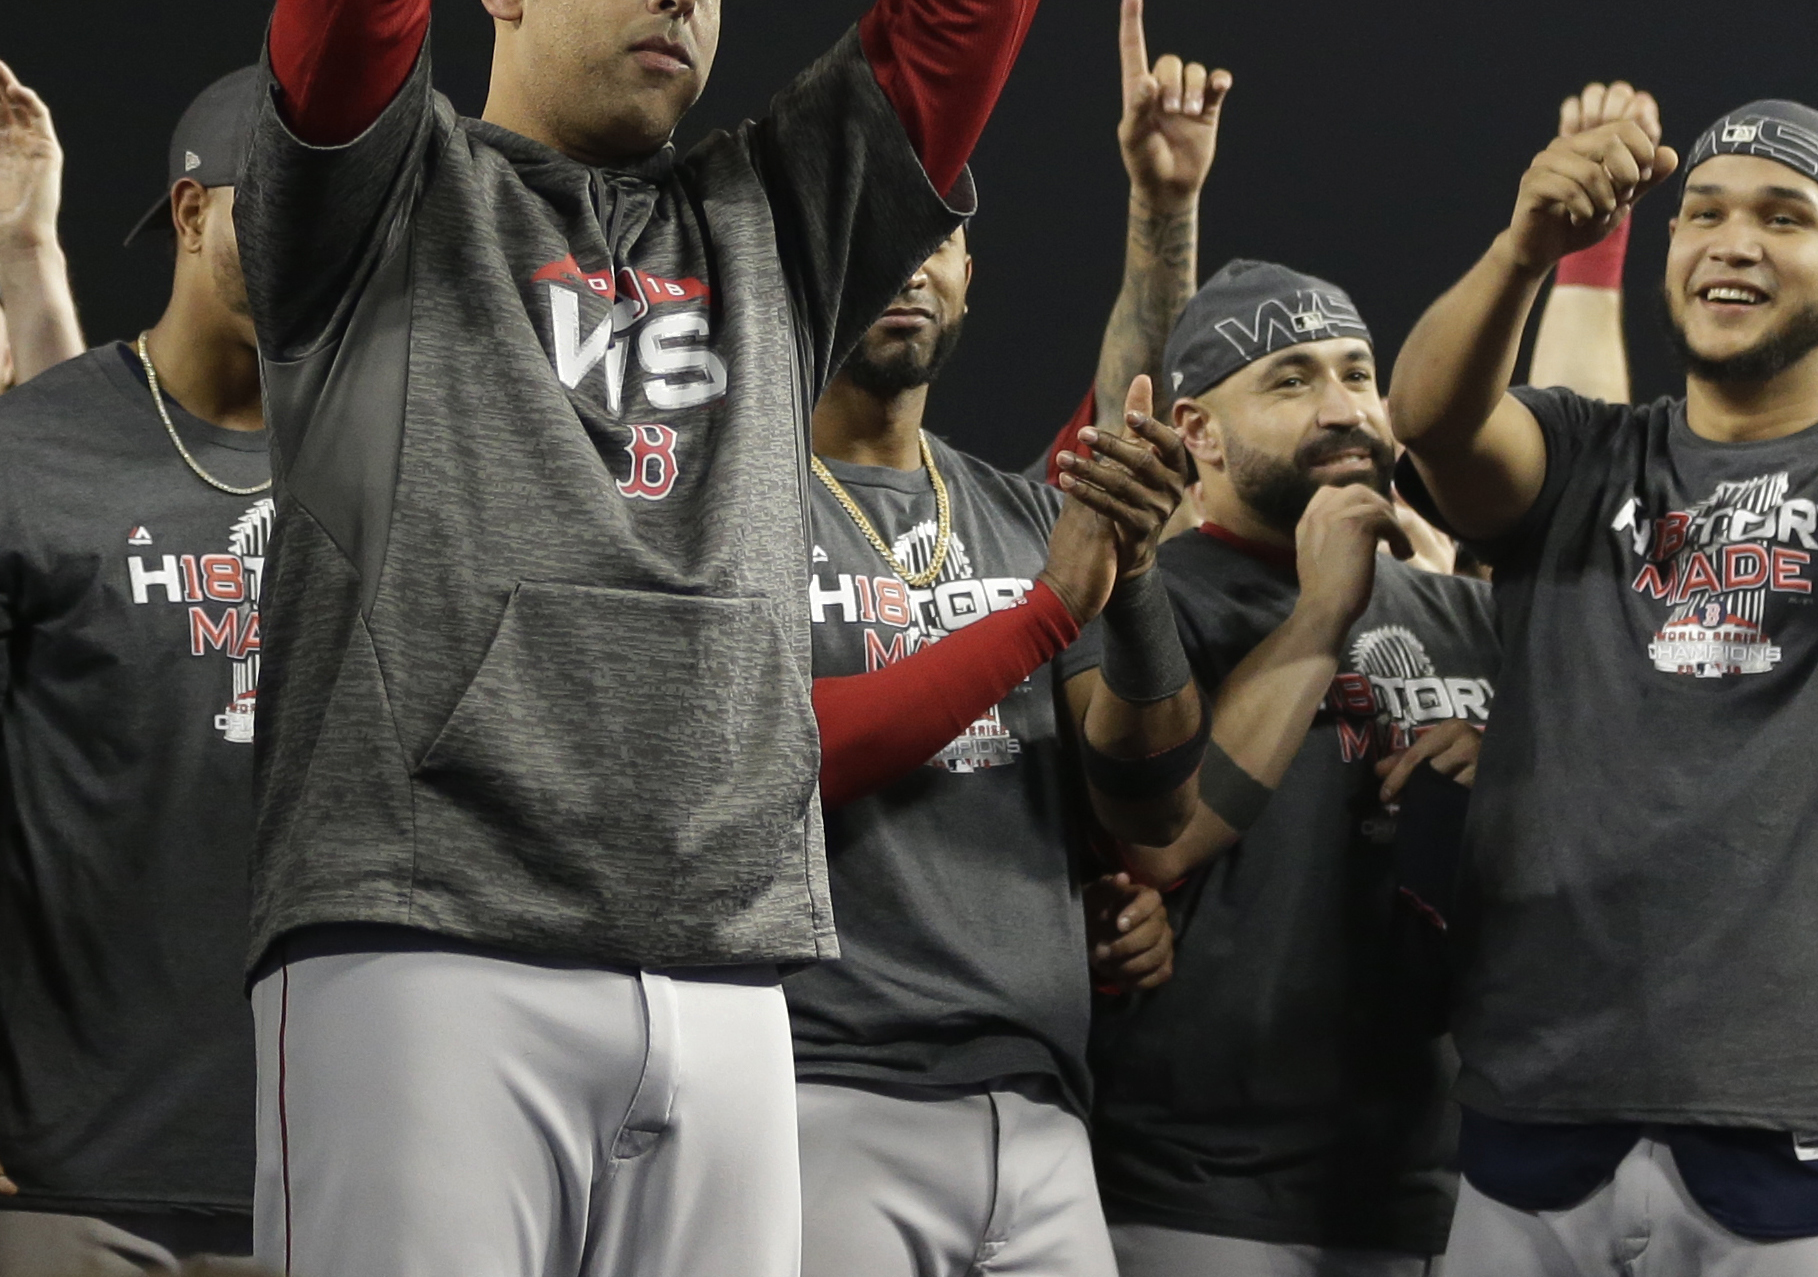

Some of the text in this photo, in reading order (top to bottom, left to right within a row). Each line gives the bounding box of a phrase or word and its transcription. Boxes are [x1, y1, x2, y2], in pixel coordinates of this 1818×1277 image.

[616, 424, 678, 500] B
[1631, 543, 1813, 607] MADE
[1647, 643, 1782, 662] CHAMPIONS
[1655, 631, 1707, 642] WORLD
